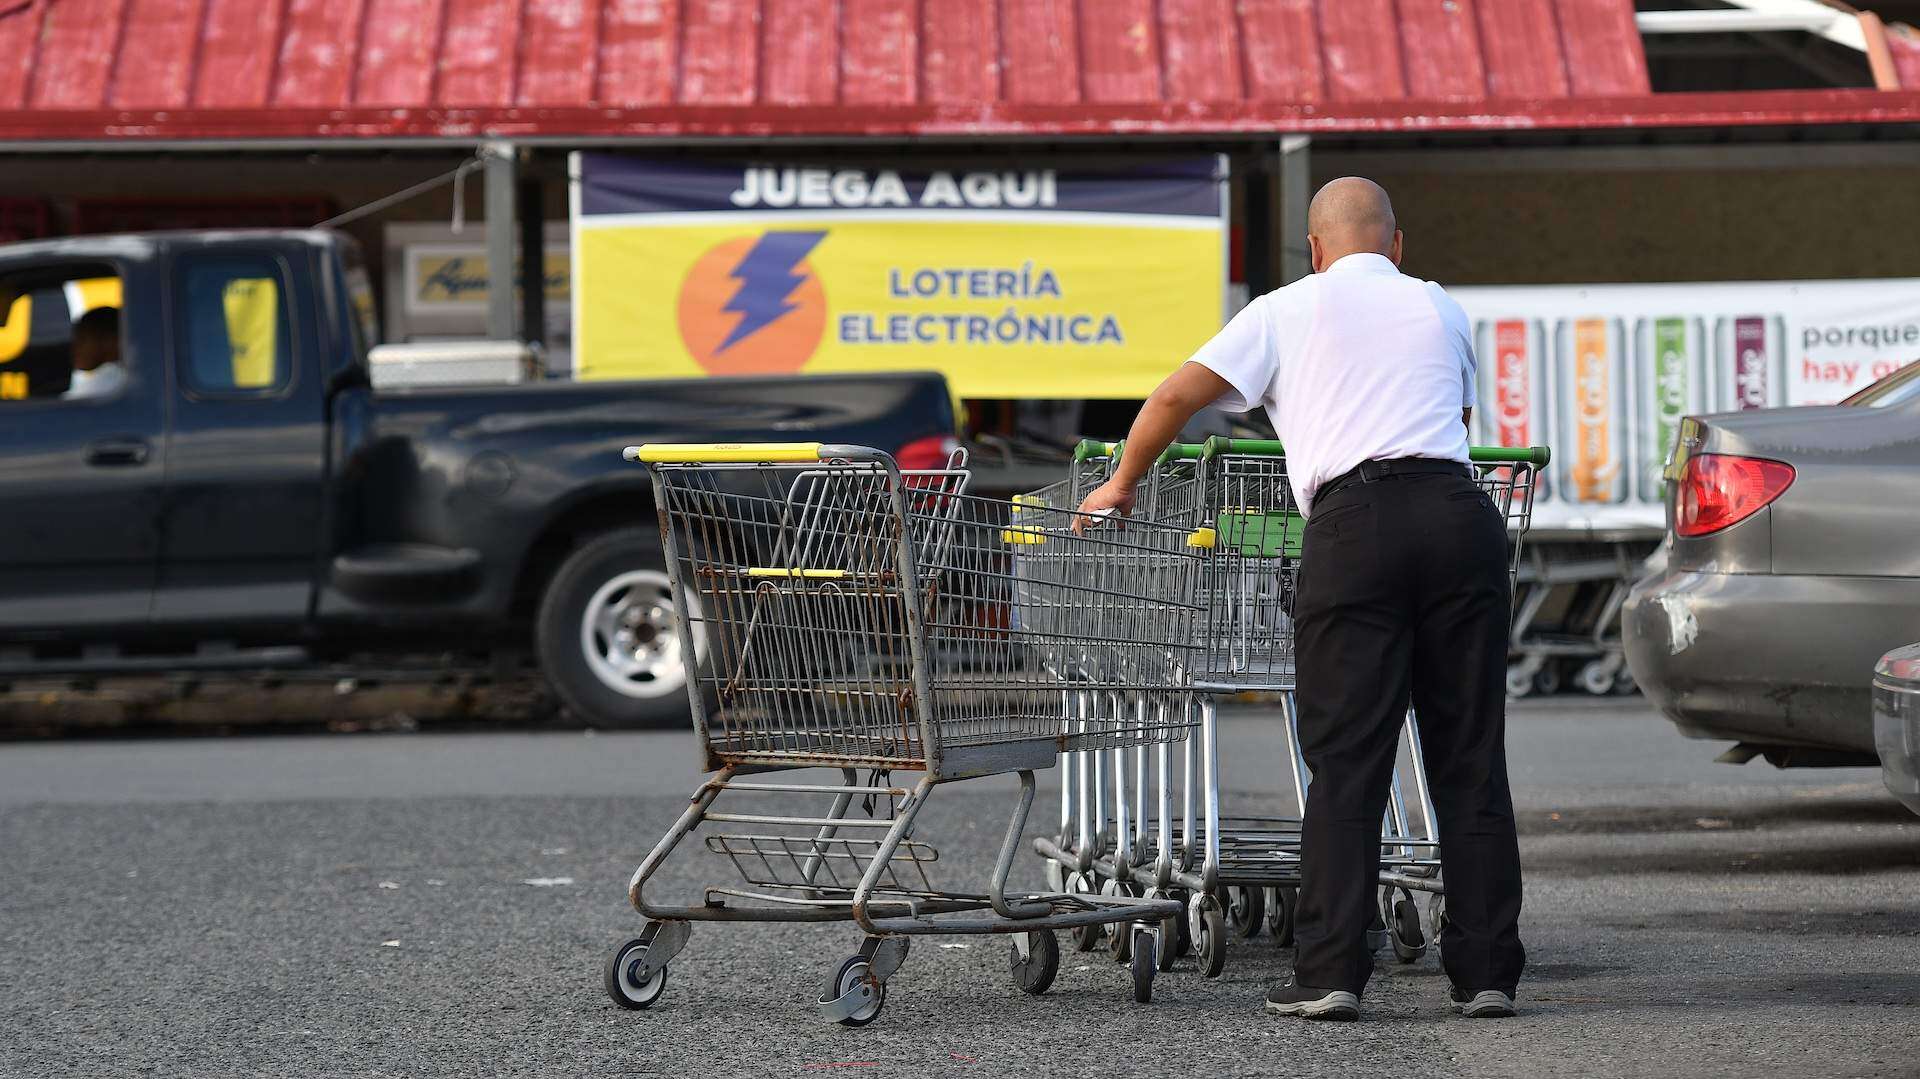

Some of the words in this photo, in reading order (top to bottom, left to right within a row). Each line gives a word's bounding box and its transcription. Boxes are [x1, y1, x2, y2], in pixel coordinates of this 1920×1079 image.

[730, 168, 912, 207] JUEGA
[890, 260, 1061, 298] LOTERÍA
[838, 307, 1123, 345] ELECTRÓNICA
[1802, 325, 1920, 351] porque
[1802, 356, 1860, 385] hay
